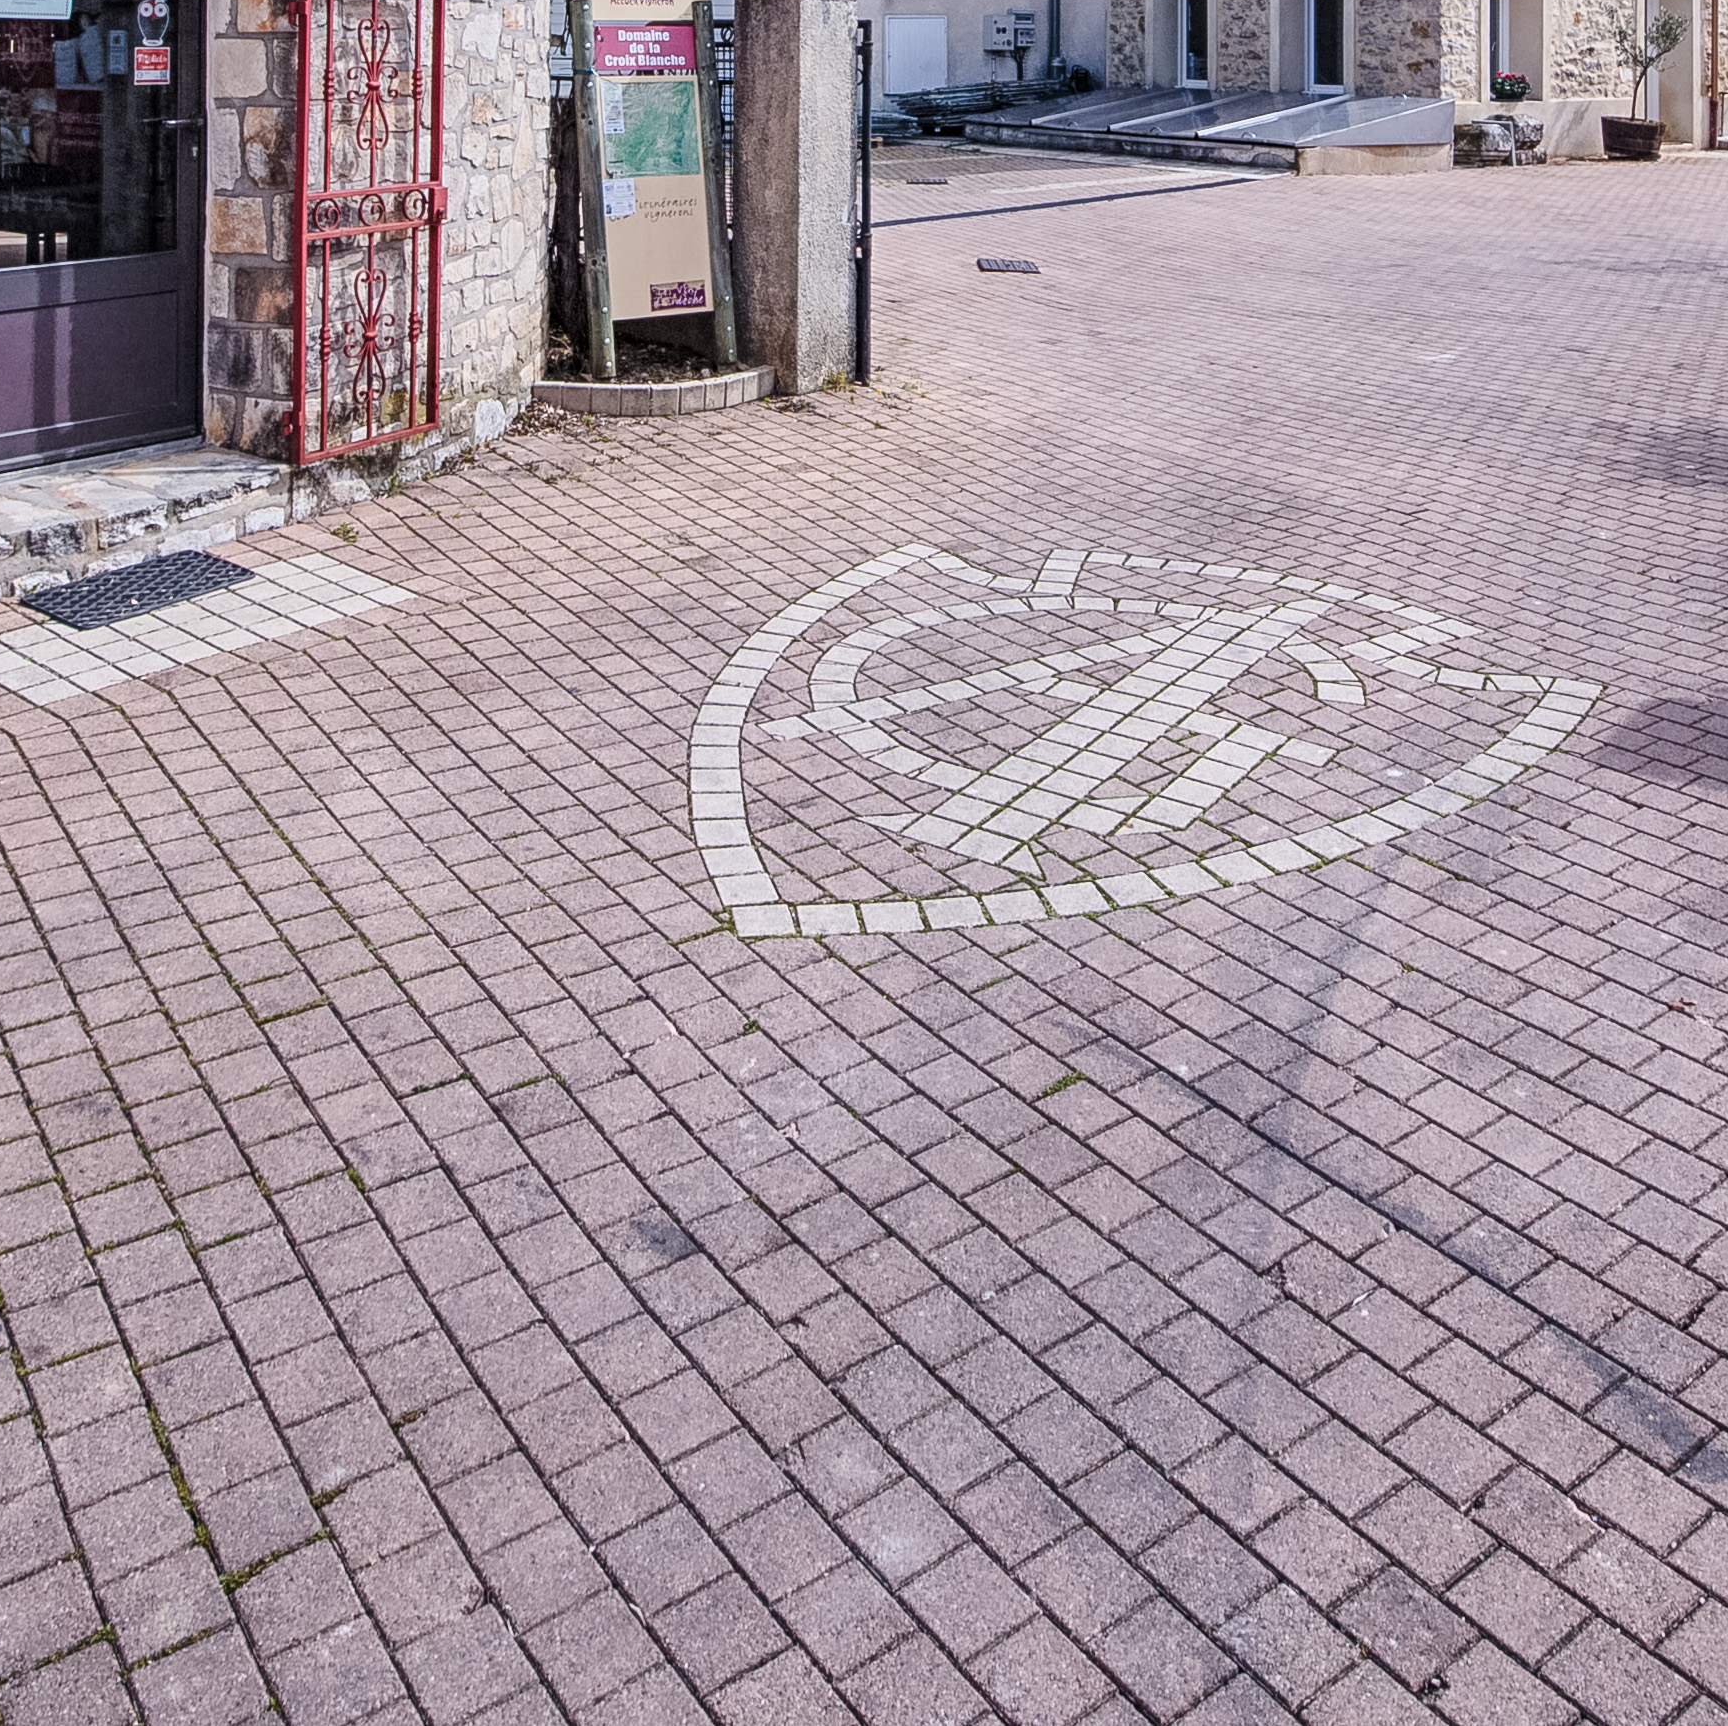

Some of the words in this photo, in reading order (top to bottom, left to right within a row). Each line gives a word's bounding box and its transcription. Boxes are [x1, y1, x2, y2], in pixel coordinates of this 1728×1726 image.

[617, 30, 670, 41] Domaine
[629, 42, 644, 53] de
[649, 42, 661, 53] la
[604, 54, 636, 67] Croix
[637, 54, 686, 66] Blanche
